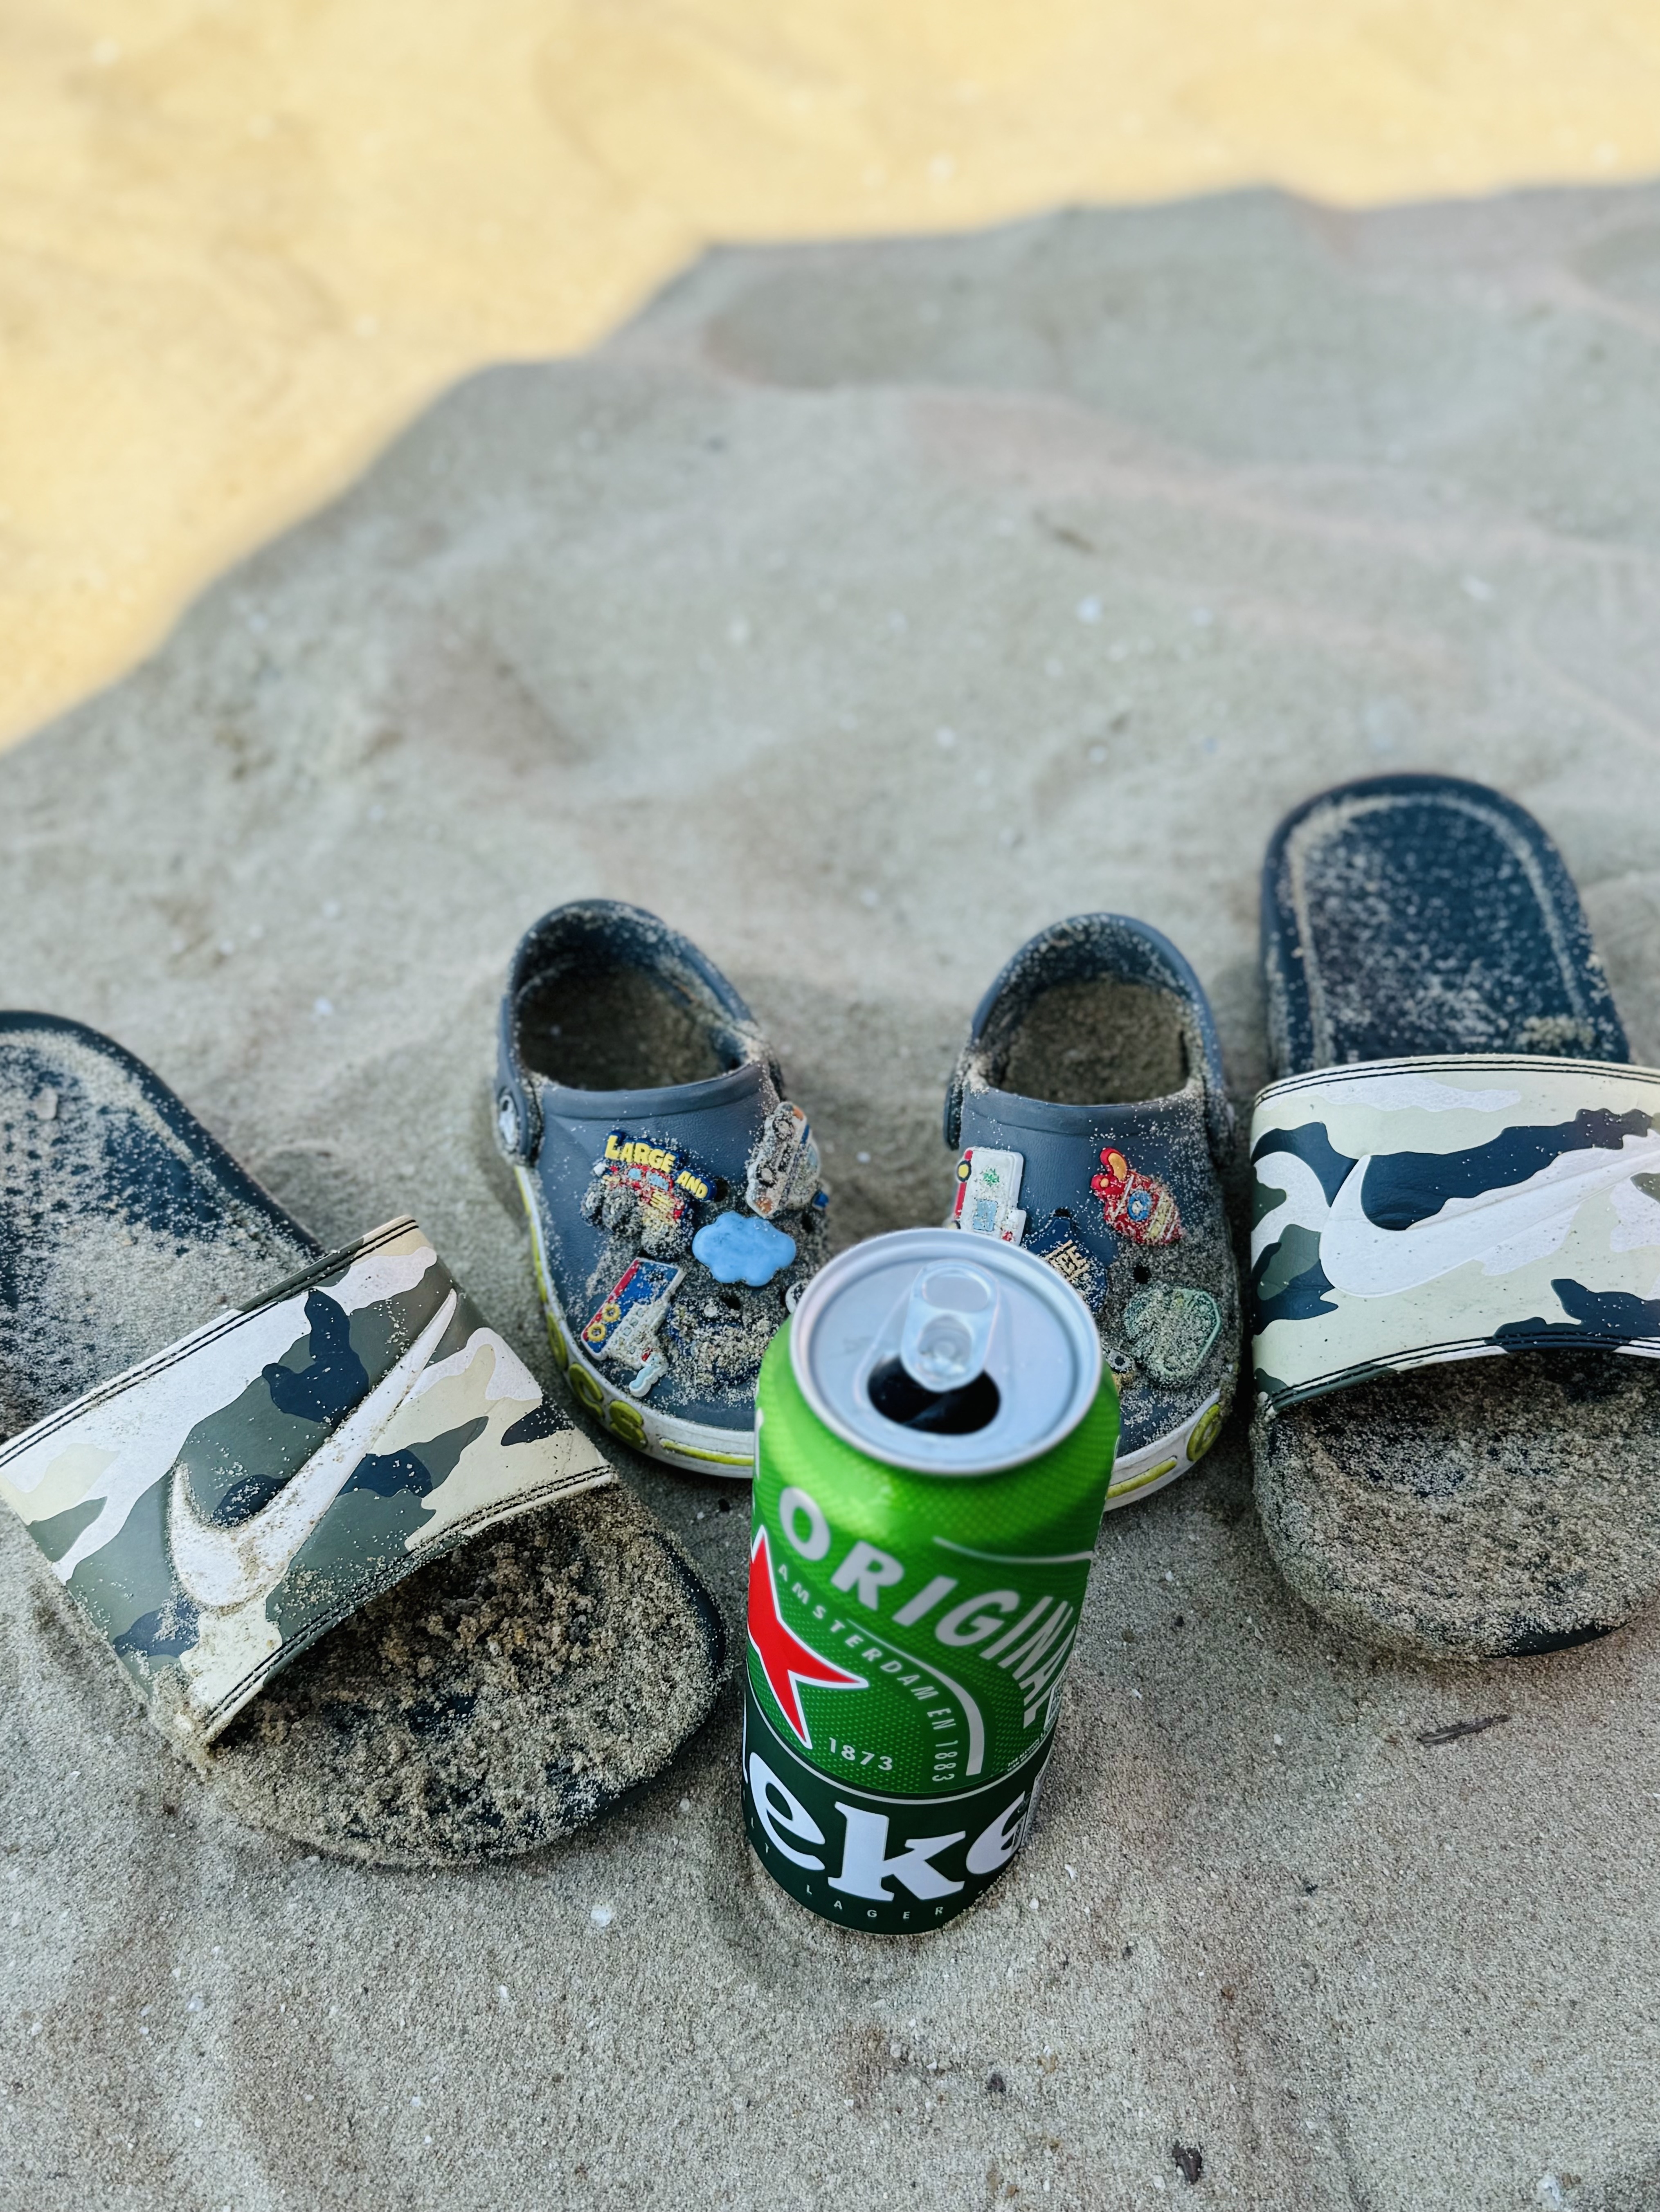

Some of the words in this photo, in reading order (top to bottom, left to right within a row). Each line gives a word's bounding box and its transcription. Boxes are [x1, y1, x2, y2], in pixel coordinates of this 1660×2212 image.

[604, 1134, 676, 1174] LARGE
[677, 1170, 708, 1199] AND
[779, 1487, 1076, 1729] ORIGINAL
[778, 1564, 939, 1700] AMSTERDAM
[927, 1707, 956, 1730] EN
[829, 1736, 893, 1771] 1873
[932, 1740, 958, 1781] 1883
[806, 1884, 943, 1920] LAGER
